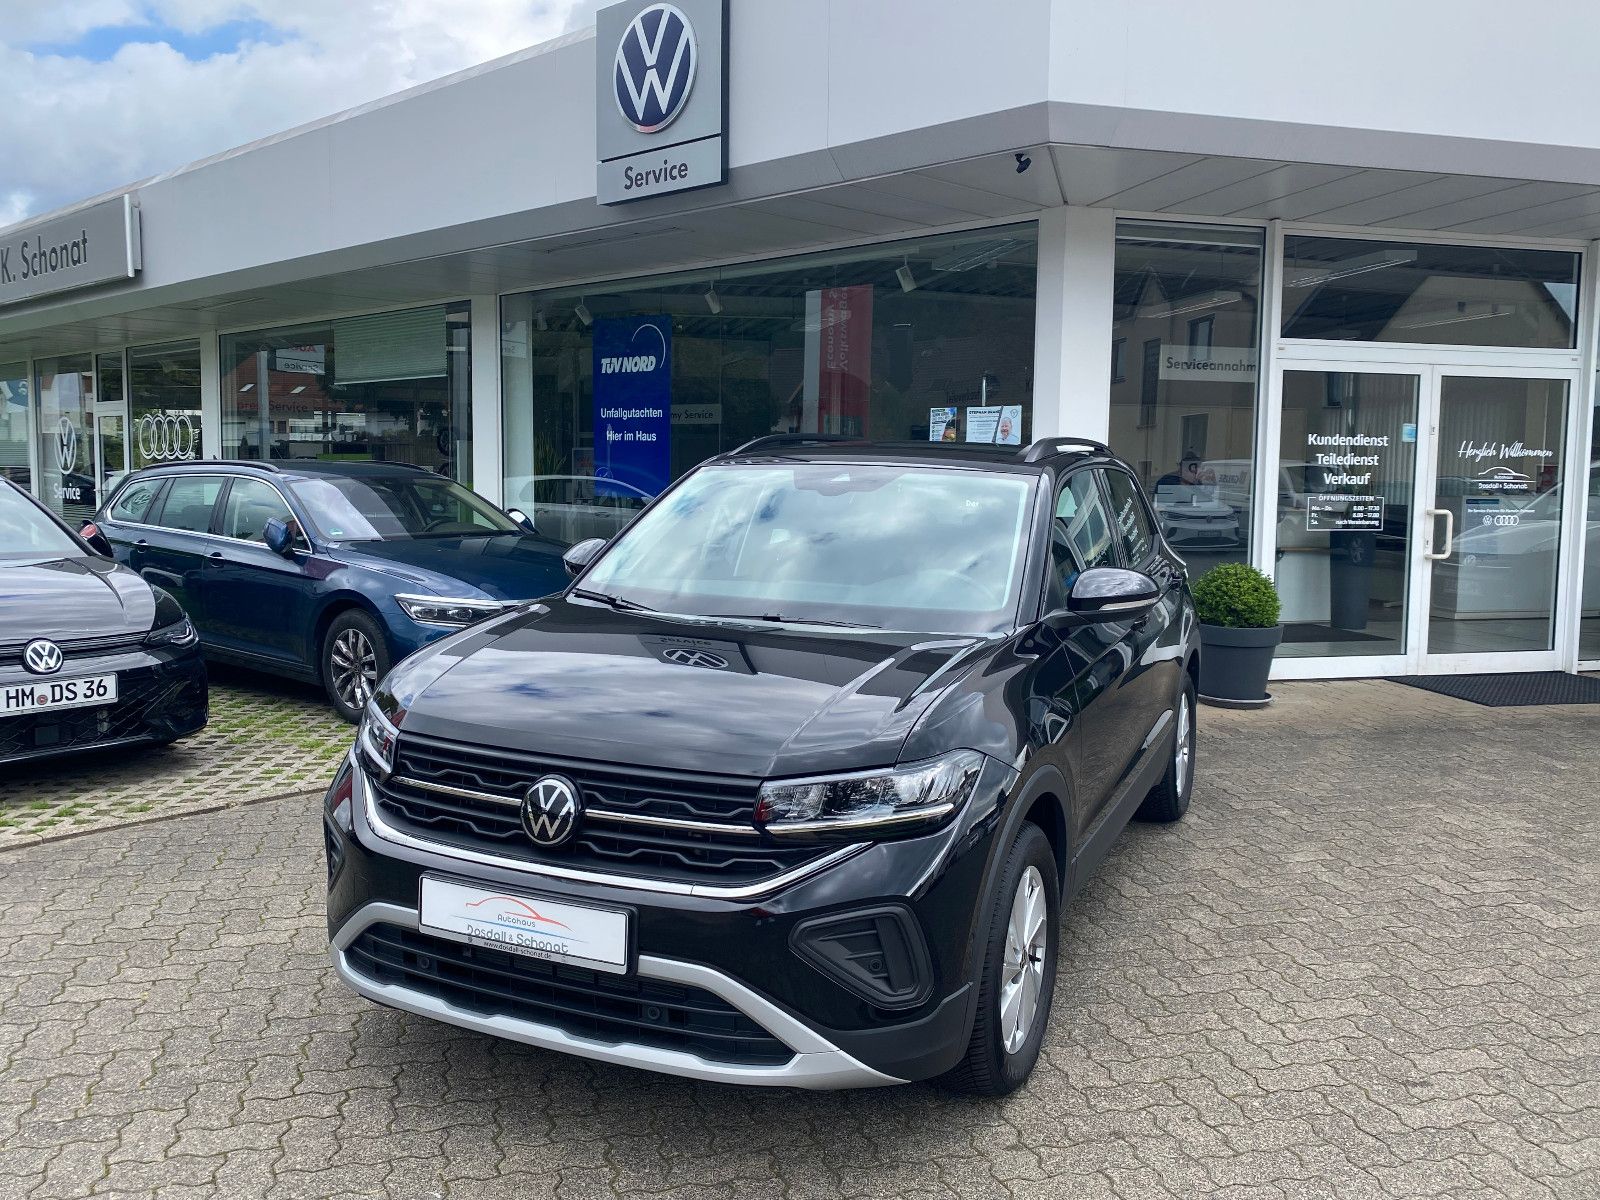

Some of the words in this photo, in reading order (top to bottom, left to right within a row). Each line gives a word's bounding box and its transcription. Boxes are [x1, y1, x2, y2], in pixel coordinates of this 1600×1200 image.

[624, 159, 688, 190] Service
[0, 247, 16, 284] K.
[21, 230, 88, 280] Schonat
[622, 355, 656, 373] NORD
[600, 407, 663, 420] Unfallgutachten
[684, 410, 713, 419] Service
[606, 430, 623, 441] Hier
[624, 430, 634, 441] im
[636, 430, 657, 441] Haus
[1308, 433, 1389, 446] Kundendienst
[1499, 440, 1553, 460] Willkommen
[1316, 453, 1379, 466] Teiledienst
[1323, 472, 1371, 485] Verkauf
[54, 483, 81, 500] Service
[1318, 494, 1375, 502] ÖFFNUNGSZEITEN
[6, 686, 34, 708] HM
[50, 682, 78, 703] DS
[83, 679, 108, 699] 36
[497, 913, 536, 928] Autohaus
[466, 924, 506, 942] Dosdall
[508, 934, 514, 942] &
[516, 933, 569, 954] Schonat
